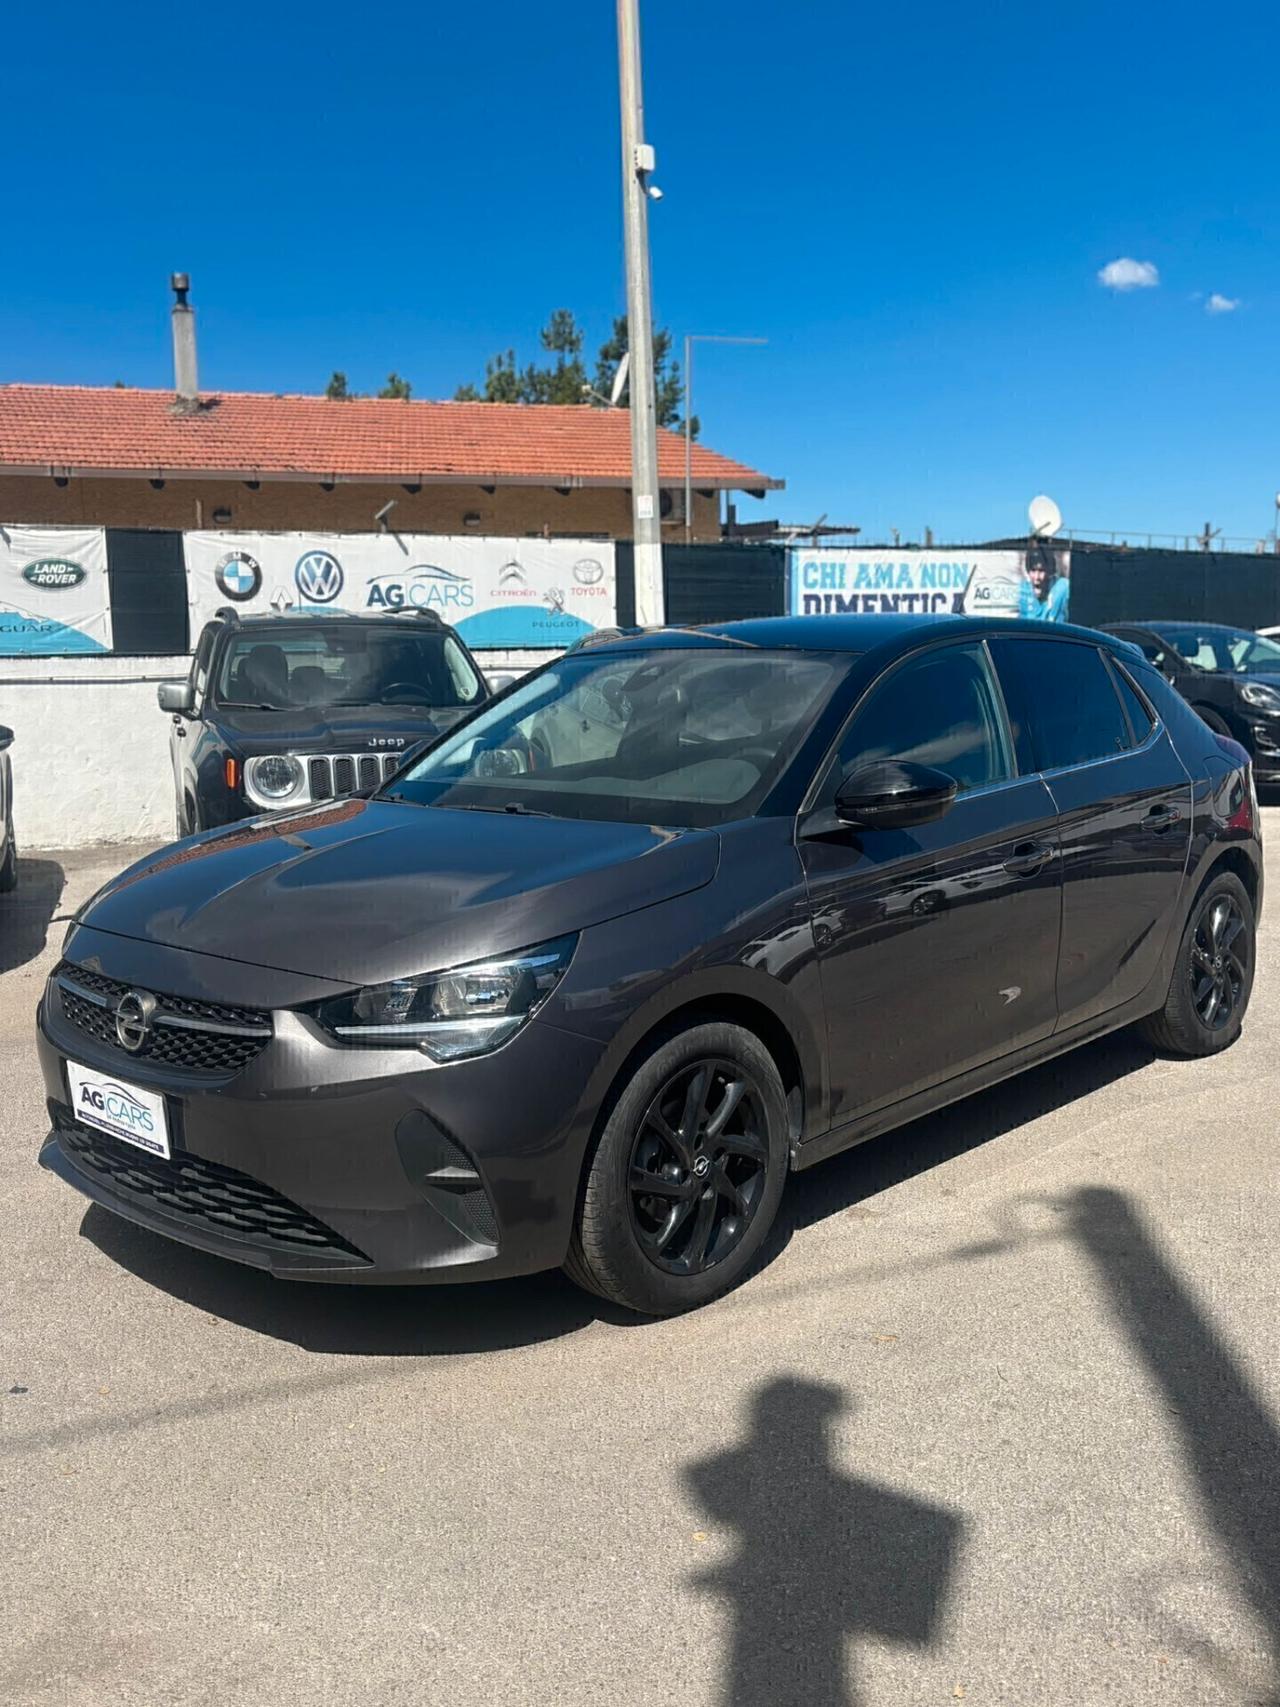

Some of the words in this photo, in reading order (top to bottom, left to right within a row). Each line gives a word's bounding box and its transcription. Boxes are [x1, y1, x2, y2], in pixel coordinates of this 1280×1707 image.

[34, 563, 66, 574] LAND
[37, 574, 77, 584] ROVER
[802, 562, 846, 589] CHI
[853, 562, 913, 589] AMA
[920, 562, 968, 589] NON
[366, 583, 404, 607] AG
[408, 583, 474, 608] CARS
[571, 587, 608, 596] TOYOTA
[974, 587, 990, 600] AG
[532, 620, 579, 629] PEUGEOT
[368, 737, 405, 747] Jeep
[81, 1085, 105, 1111] AG
[106, 1097, 154, 1132] CARS
